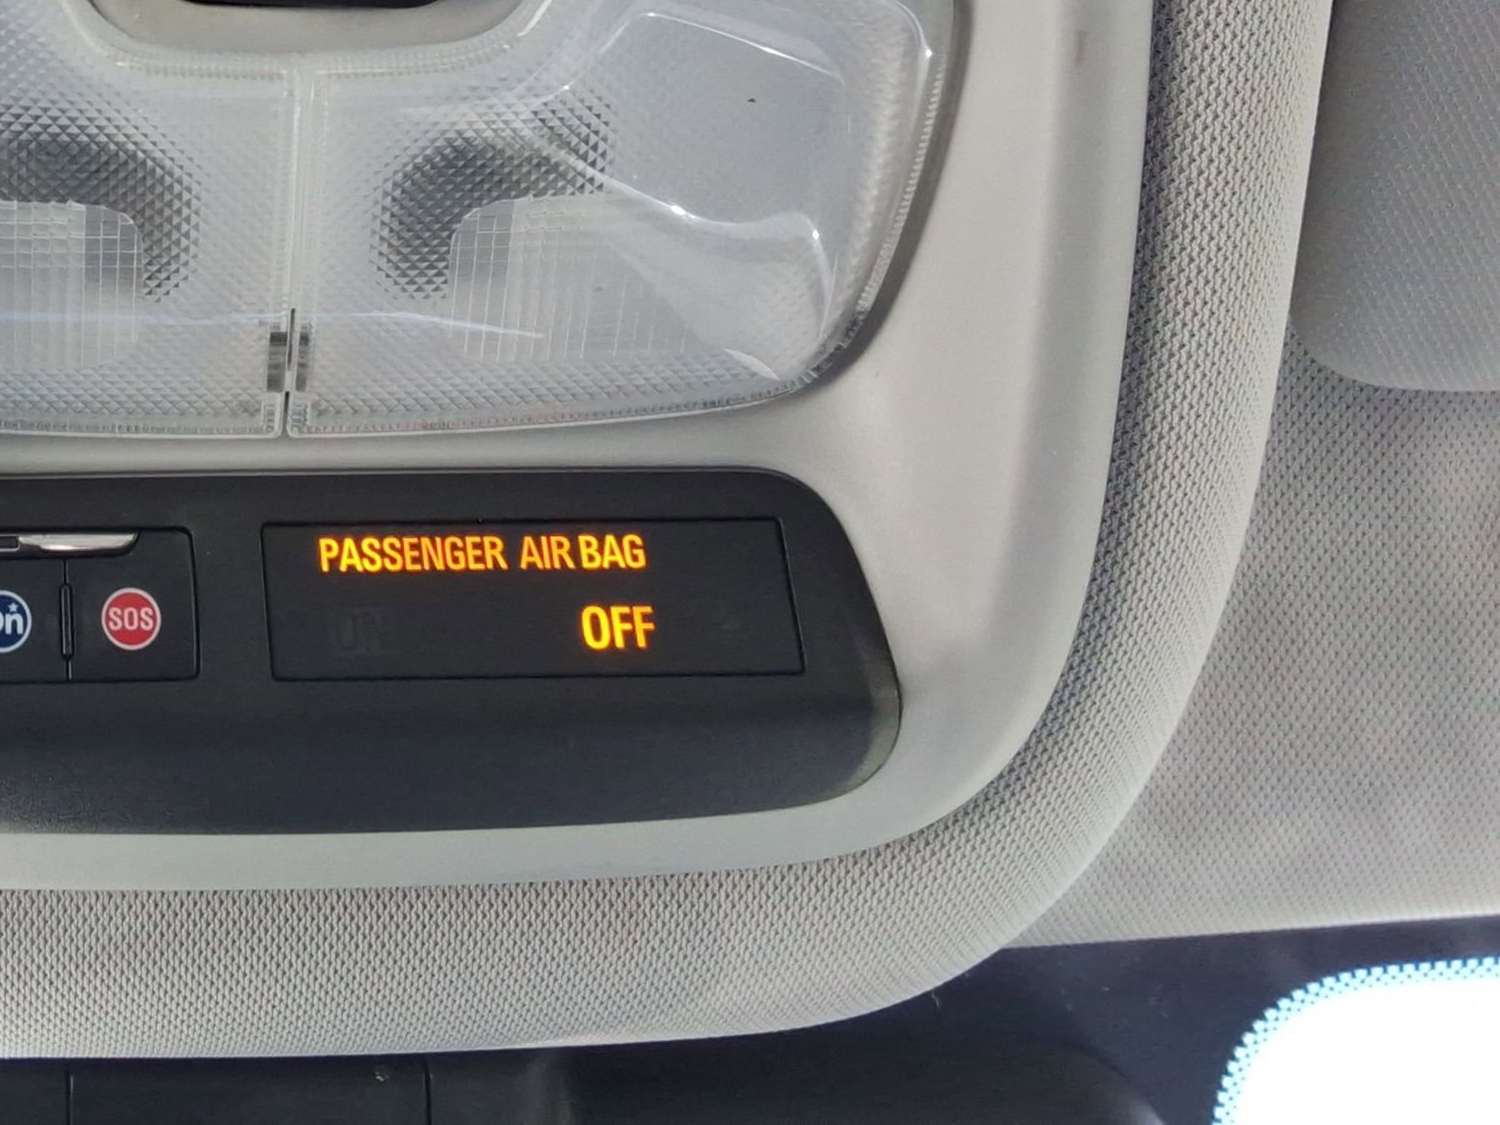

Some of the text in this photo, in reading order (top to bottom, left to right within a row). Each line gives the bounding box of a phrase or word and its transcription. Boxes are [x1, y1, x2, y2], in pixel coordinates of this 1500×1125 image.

[318, 535, 509, 573] PASSENGER
[108, 606, 154, 631] SOS
[581, 605, 656, 651] OFF
